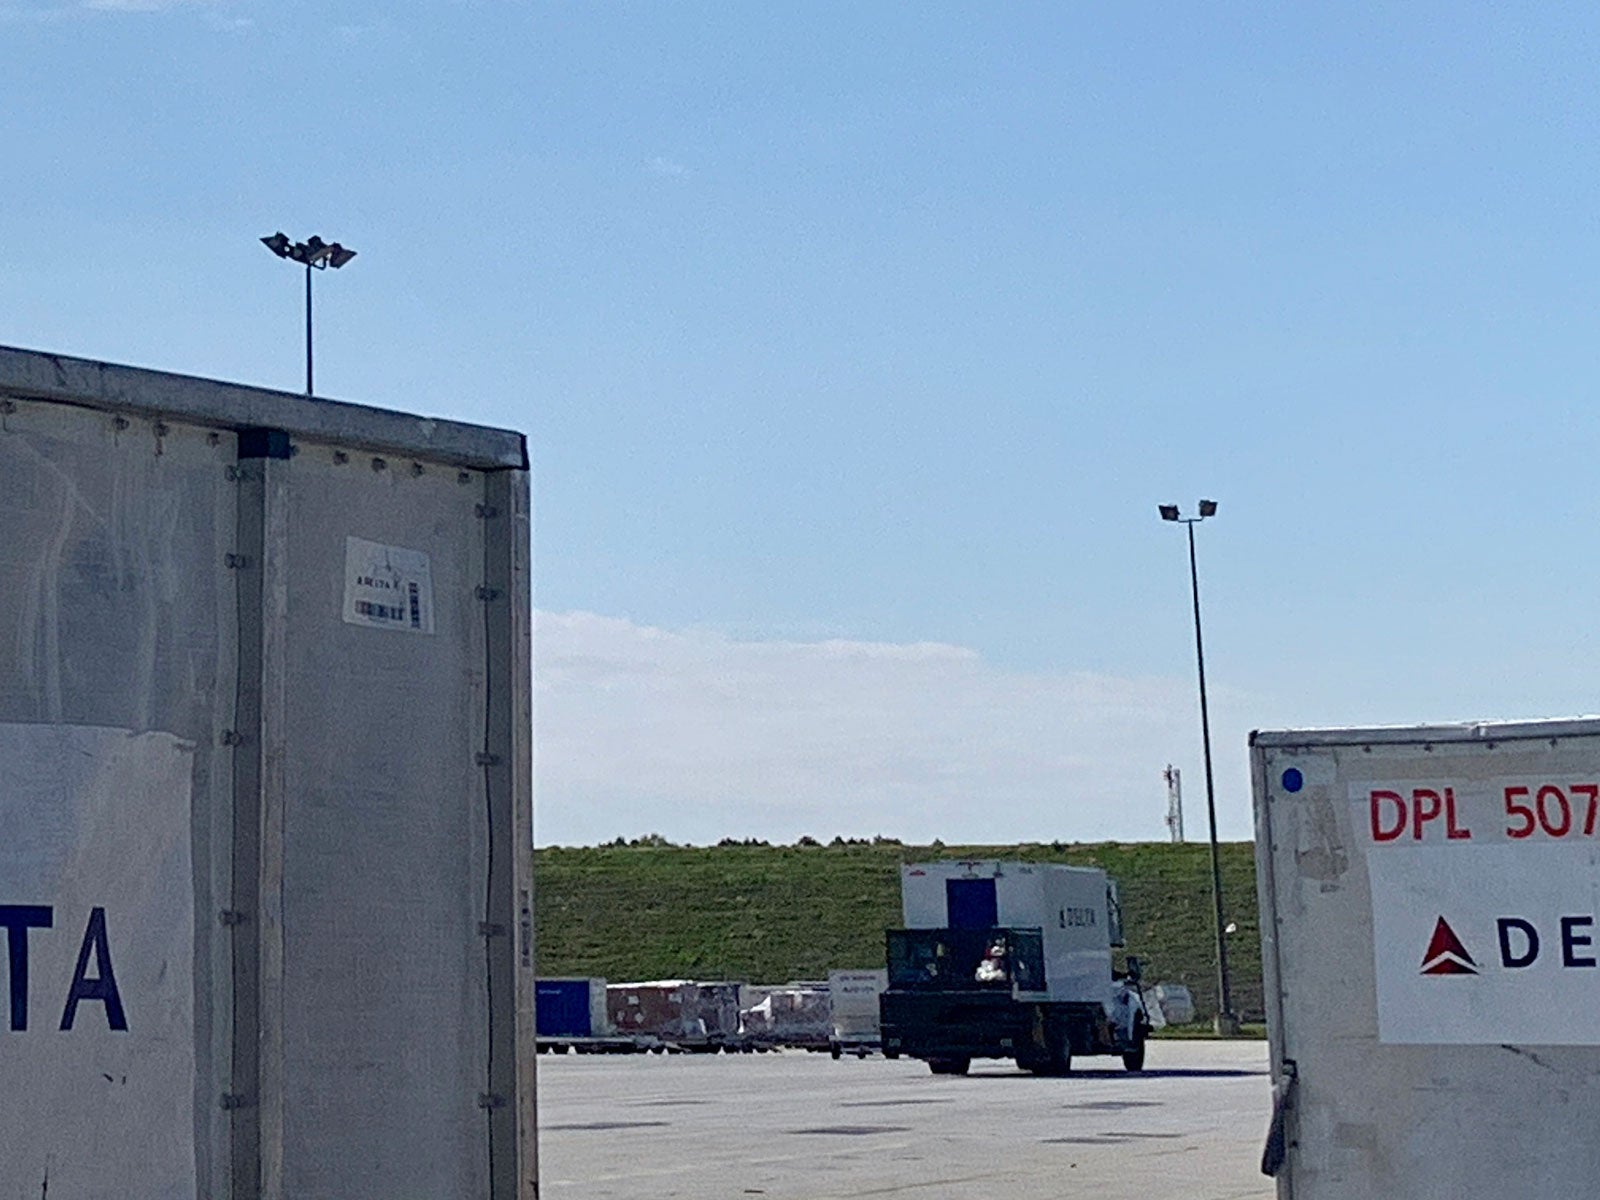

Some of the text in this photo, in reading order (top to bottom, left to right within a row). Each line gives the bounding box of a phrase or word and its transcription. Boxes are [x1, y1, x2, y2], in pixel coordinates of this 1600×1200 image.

[1370, 784, 1598, 841] DPL 507
[1496, 916, 1597, 969] DE
